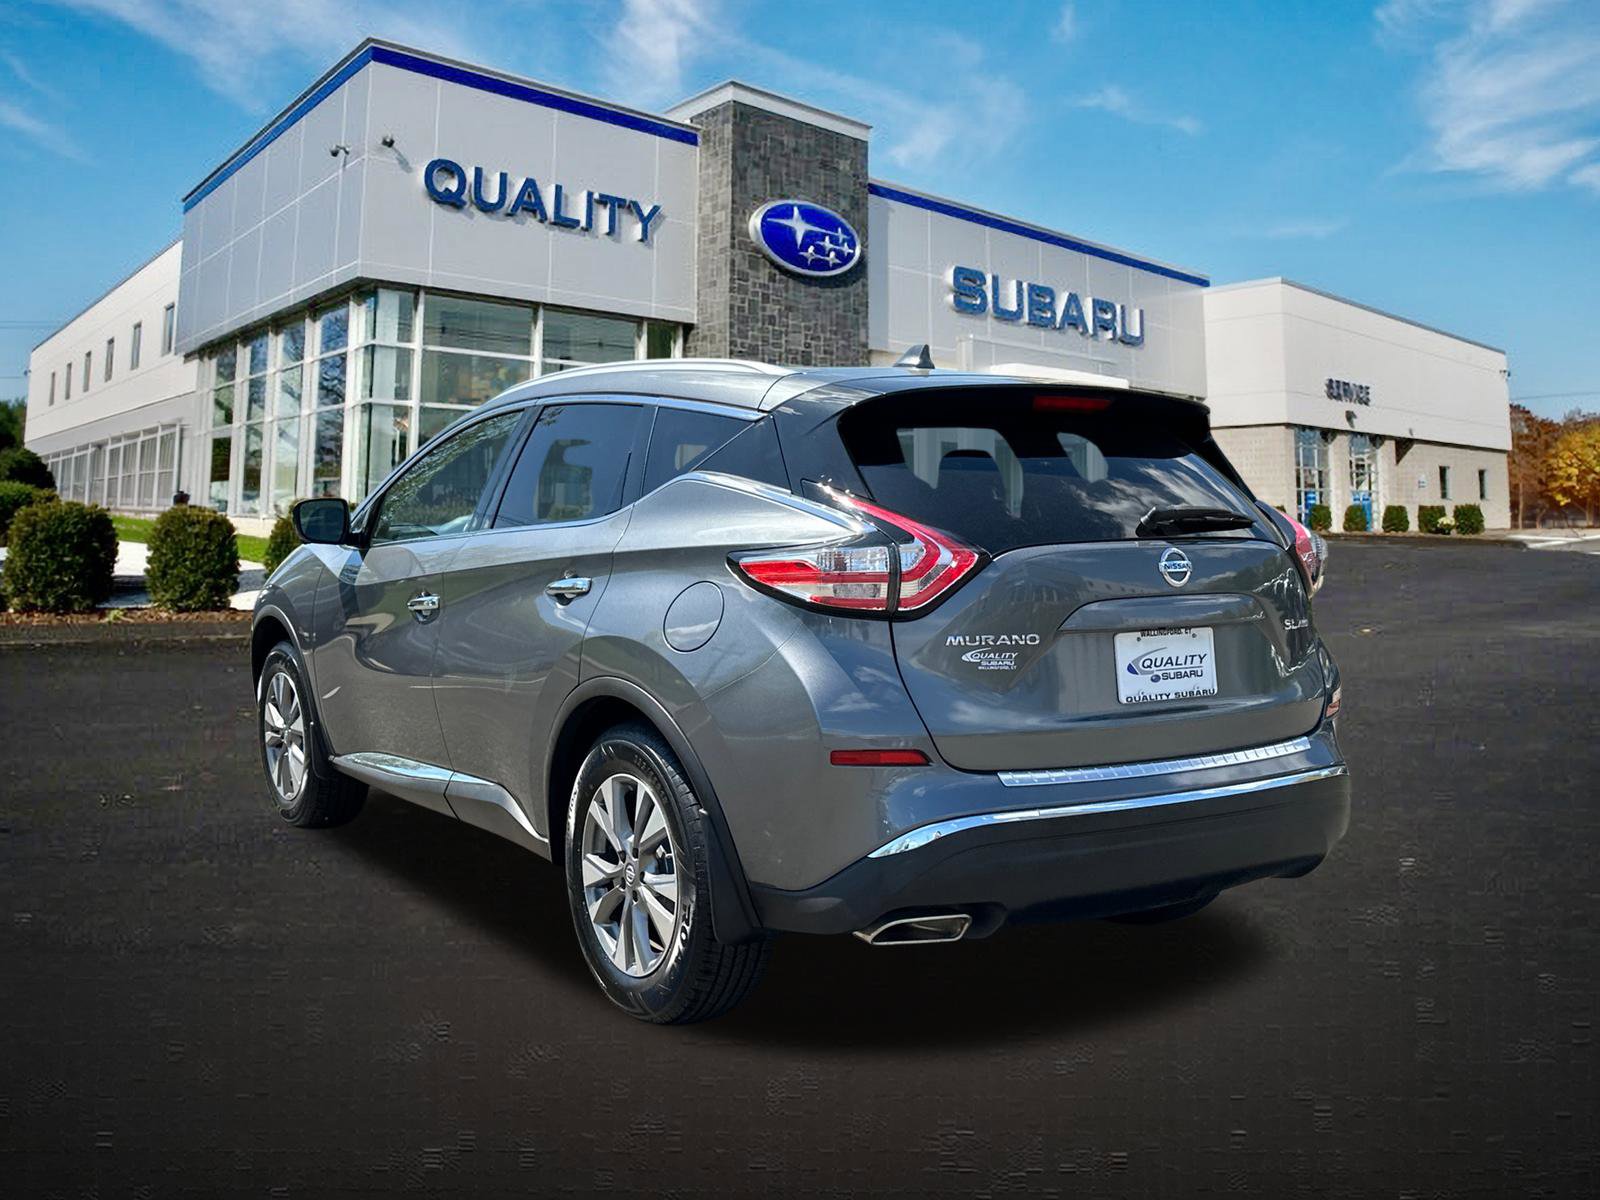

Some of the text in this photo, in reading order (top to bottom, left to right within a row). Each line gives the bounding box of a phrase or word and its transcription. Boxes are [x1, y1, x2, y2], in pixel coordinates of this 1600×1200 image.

[424, 158, 662, 243] QUALITY
[952, 265, 1145, 346] SUBARU
[1163, 561, 1191, 570] NISSAN
[945, 633, 1040, 646] MURANO
[971, 652, 1019, 660] QUALITY
[1141, 653, 1207, 669] QUALITY
[1161, 670, 1203, 680] SUBARU
[1126, 688, 1215, 702] QUALITY SUBARU
